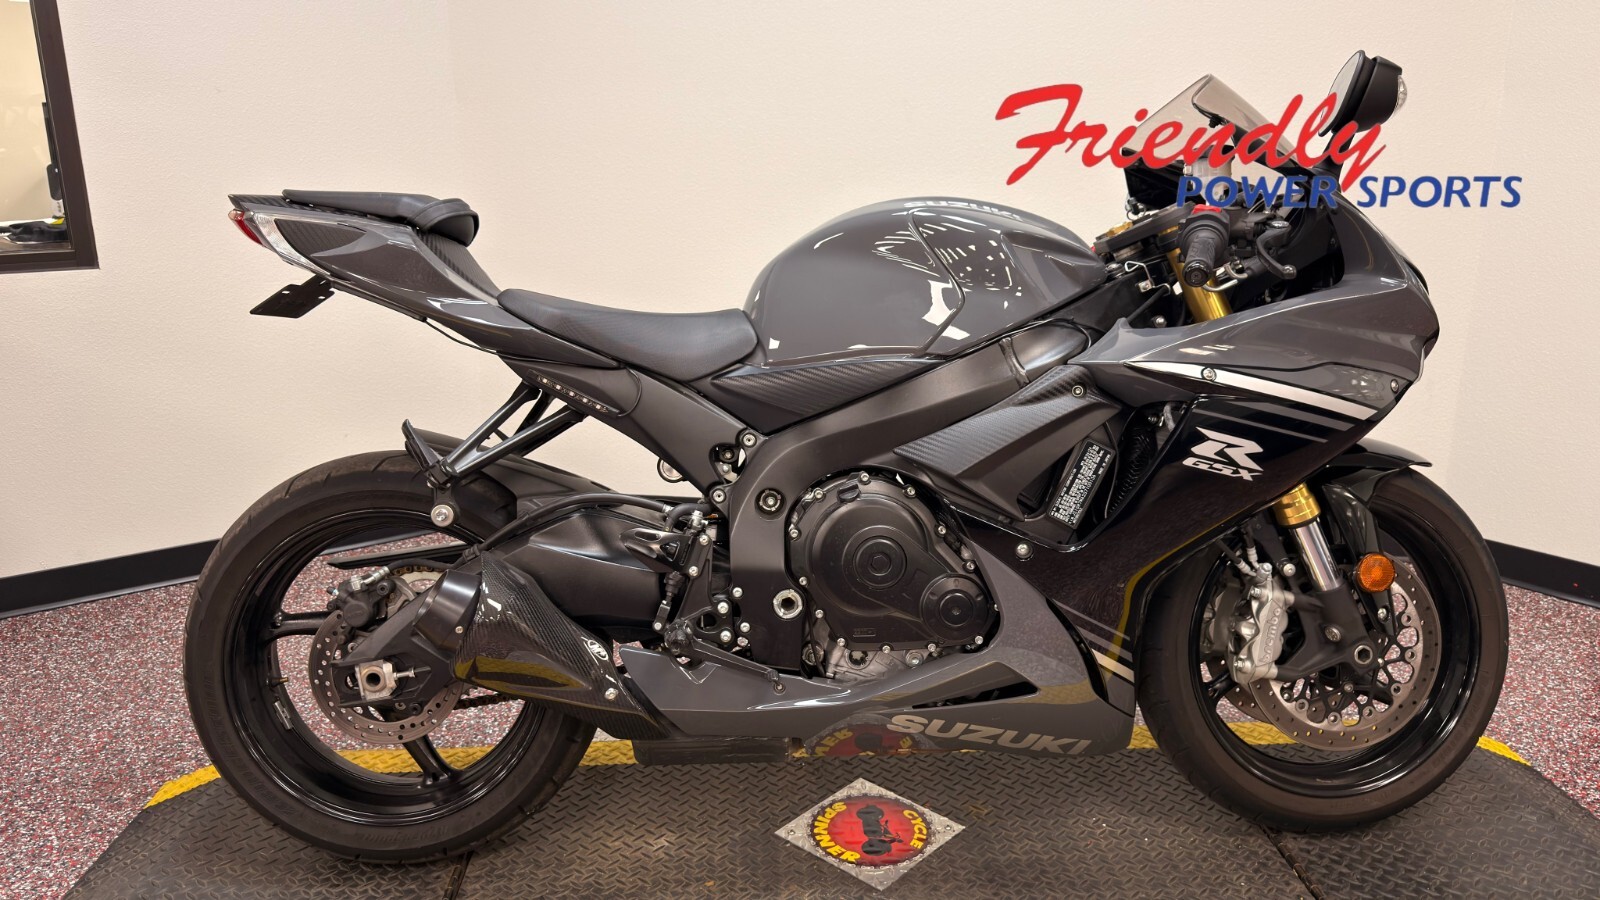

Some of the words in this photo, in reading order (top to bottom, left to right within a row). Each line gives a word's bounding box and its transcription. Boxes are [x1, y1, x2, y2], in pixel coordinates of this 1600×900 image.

[1182, 456, 1263, 482] GSX
[1259, 607, 1281, 663] brembo
[886, 714, 1092, 755] SUZUKI
[813, 801, 861, 864] SPINNER
[902, 809, 928, 850] CYCLE
